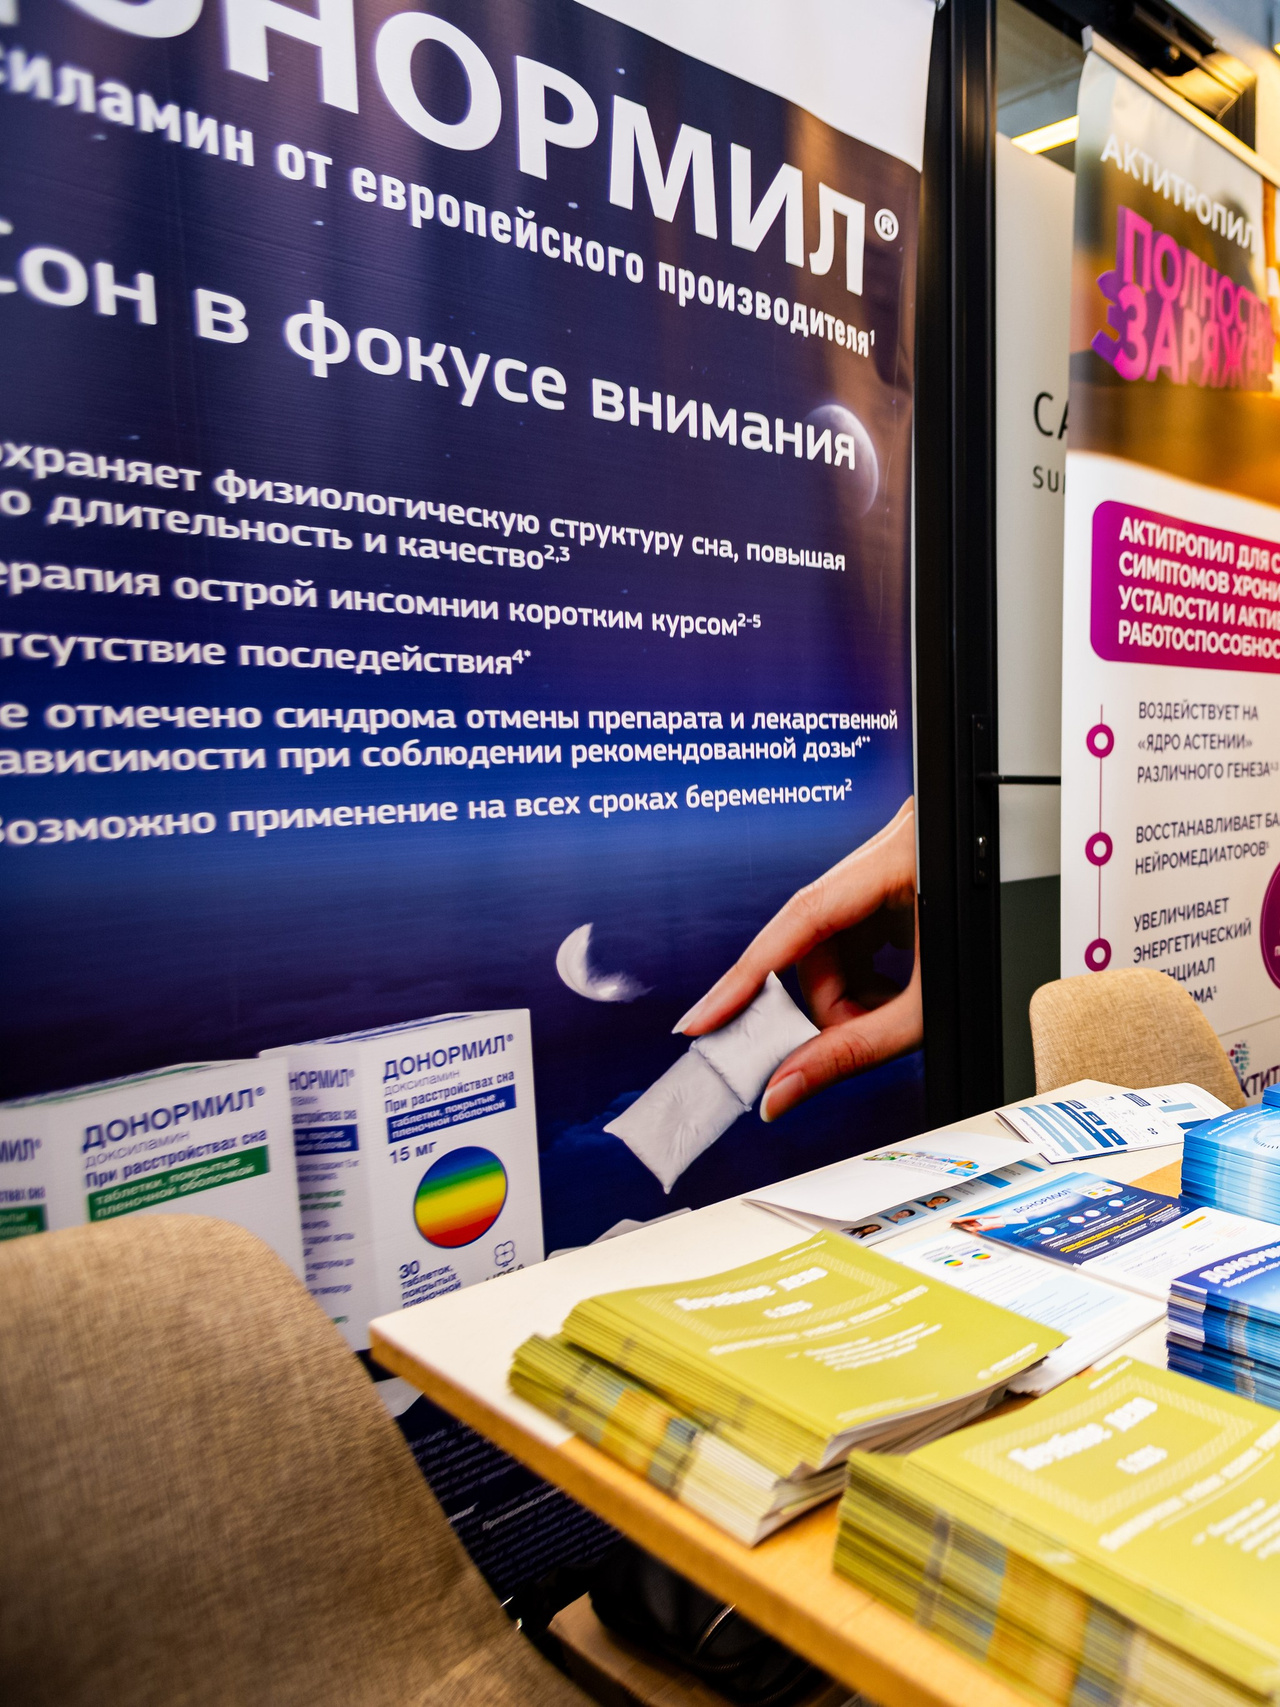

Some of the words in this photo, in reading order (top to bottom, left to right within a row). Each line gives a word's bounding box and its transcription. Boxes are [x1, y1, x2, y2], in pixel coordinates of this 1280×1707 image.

[0, 44, 255, 167] иламин
[275, 143, 333, 189] от
[351, 167, 644, 284] европейского
[1100, 132, 1256, 254] АКТИТРОПИЛ
[194, 288, 249, 344] в
[283, 300, 567, 411] фокусе
[591, 377, 857, 471] внимания
[1033, 464, 1065, 496] SU
[0, 440, 202, 492] храняет
[213, 469, 540, 538] физиологическую
[550, 517, 684, 557] структуру
[691, 533, 739, 563] сна,
[746, 541, 846, 572] повышая
[45, 494, 353, 551] длительность
[363, 532, 387, 554] и
[1119, 515, 1235, 565] АКТИТРОПИЛ
[1236, 544, 1269, 572] ДЛЯ
[1118, 551, 1230, 595] СИМПТОМОВ
[0, 560, 160, 597] рапия
[173, 576, 318, 611] острой
[330, 588, 499, 621] инсомнии
[508, 601, 643, 630] коротким
[1118, 584, 1219, 624] УСТАЛОСТИ
[1223, 602, 1236, 625] И
[45, 703, 263, 729] отмечено
[274, 705, 457, 736] синдрома
[466, 708, 579, 730] отмены
[588, 709, 724, 735] препарата
[730, 711, 745, 730] и
[751, 709, 899, 734] лекарственной
[1138, 699, 1240, 723] ВОЗДЕЙСТВУЕТ
[1242, 704, 1259, 721] НА
[279, 745, 351, 775] при
[361, 739, 562, 769] соблюдении
[570, 736, 797, 768] рекомендованной
[1137, 732, 1181, 754] «ЯДРО
[1183, 732, 1253, 751] АСТЕНИИ»
[1137, 762, 1224, 784] РАЗЛИЧНОГО
[0, 809, 217, 846] озможно
[229, 801, 459, 838] применение
[468, 797, 506, 820] на
[515, 794, 580, 817] всех
[589, 789, 679, 818] сроках
[1136, 812, 1263, 844] ВОССТАНАВЛИВАЕТ
[1133, 896, 1230, 933] УВЕЛИЧИВАЕТ
[1133, 916, 1252, 964] ЭНЕРГЕТИЧЕСКИЙ
[1160, 957, 1215, 982] НЦИАЛ
[384, 1096, 407, 1114] При
[411, 1074, 493, 1109] расстройствах
[496, 1070, 515, 1084] сна
[85, 1169, 118, 1190] При
[123, 1135, 238, 1181] расстройствах
[242, 1129, 268, 1146] сна
[389, 1145, 411, 1165] 15
[415, 1141, 438, 1158] мг
[398, 1260, 421, 1279] 30
